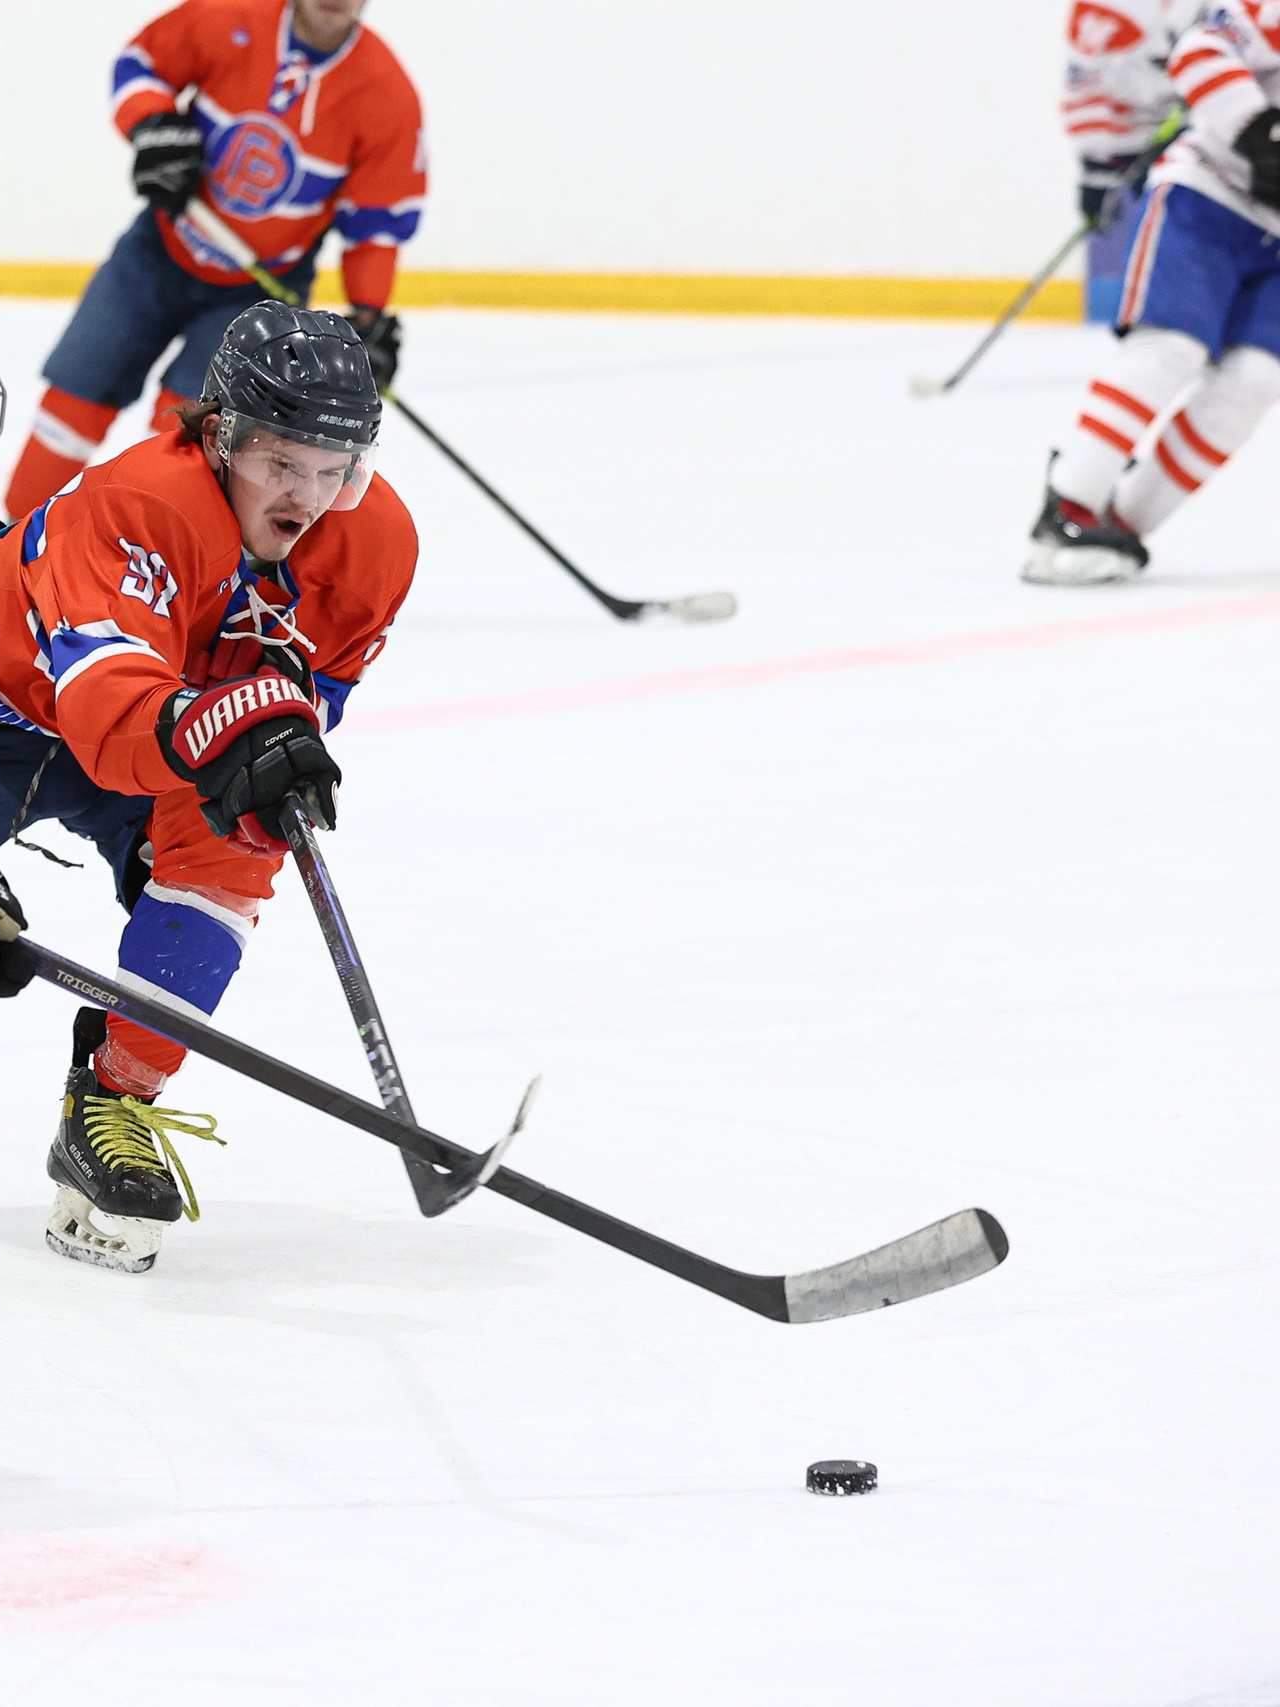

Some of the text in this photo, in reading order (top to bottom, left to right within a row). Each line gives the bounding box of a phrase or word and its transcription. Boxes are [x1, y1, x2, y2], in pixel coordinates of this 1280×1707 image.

[316, 413, 364, 430] BAUER
[184, 677, 313, 762] WARRIO
[265, 727, 294, 747] COVERT
[56, 969, 119, 1006] TRIGGER
